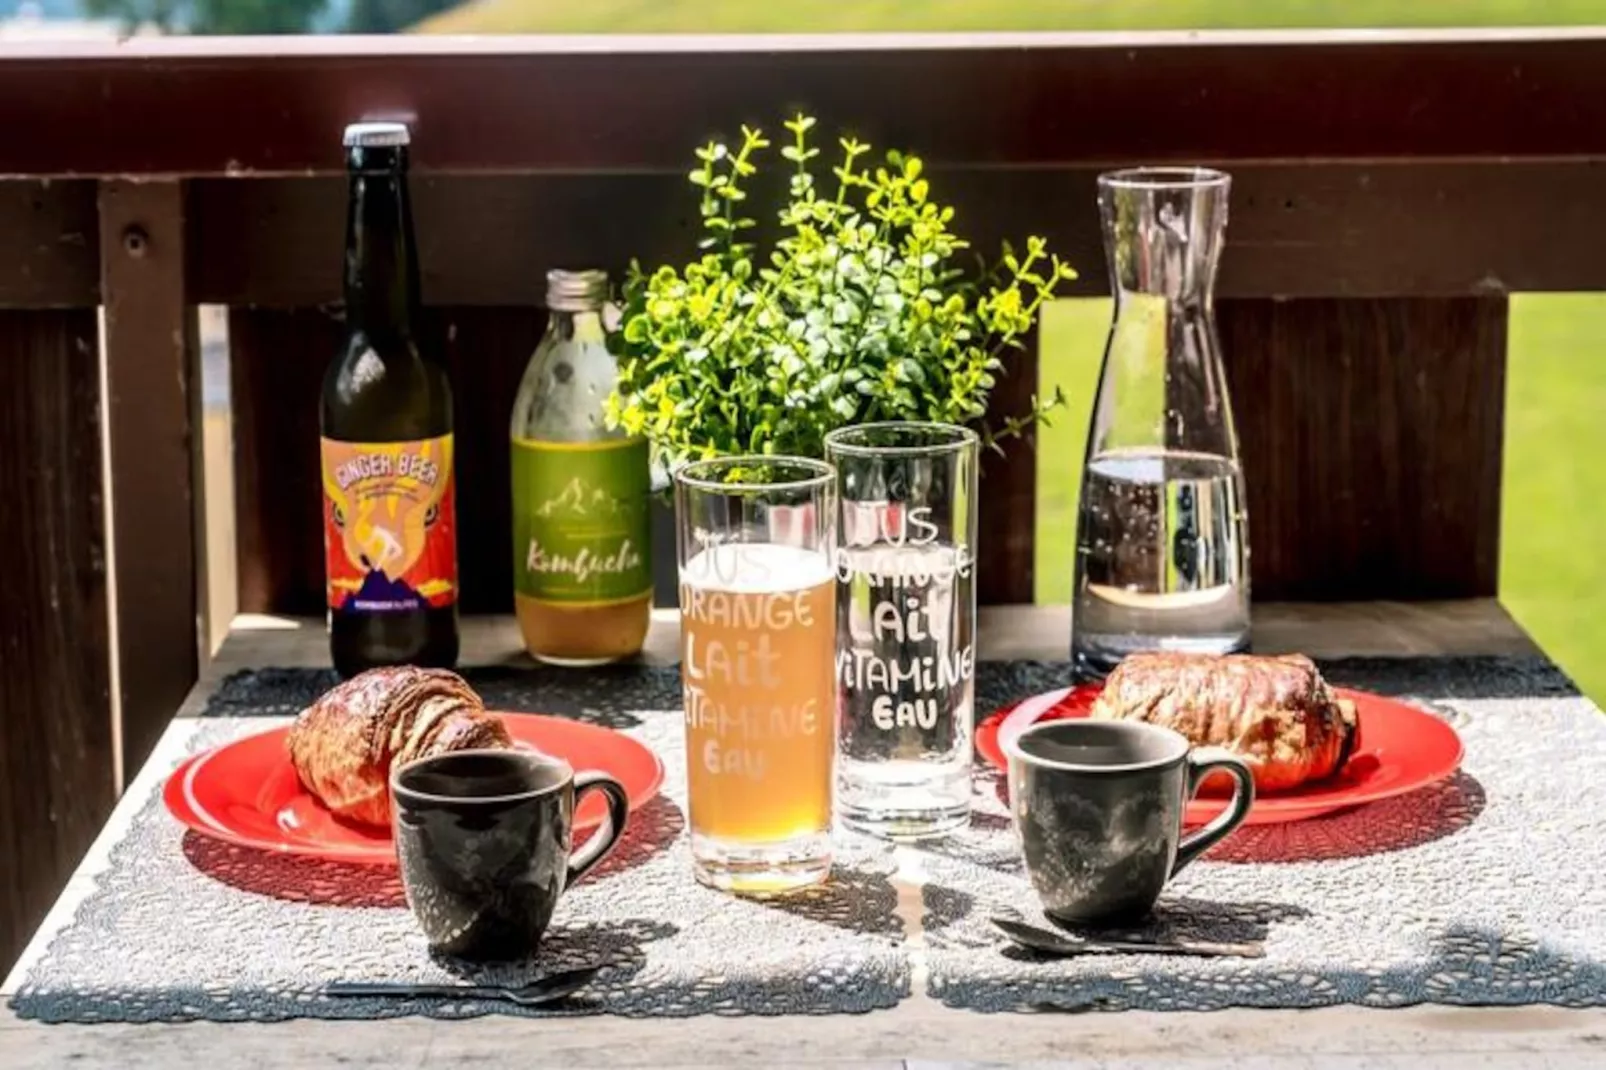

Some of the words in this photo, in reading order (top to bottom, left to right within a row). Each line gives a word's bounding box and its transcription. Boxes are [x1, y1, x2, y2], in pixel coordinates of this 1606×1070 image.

[335, 453, 393, 490] GINGER
[399, 453, 438, 488] BEER
[527, 538, 640, 583] Kombucha
